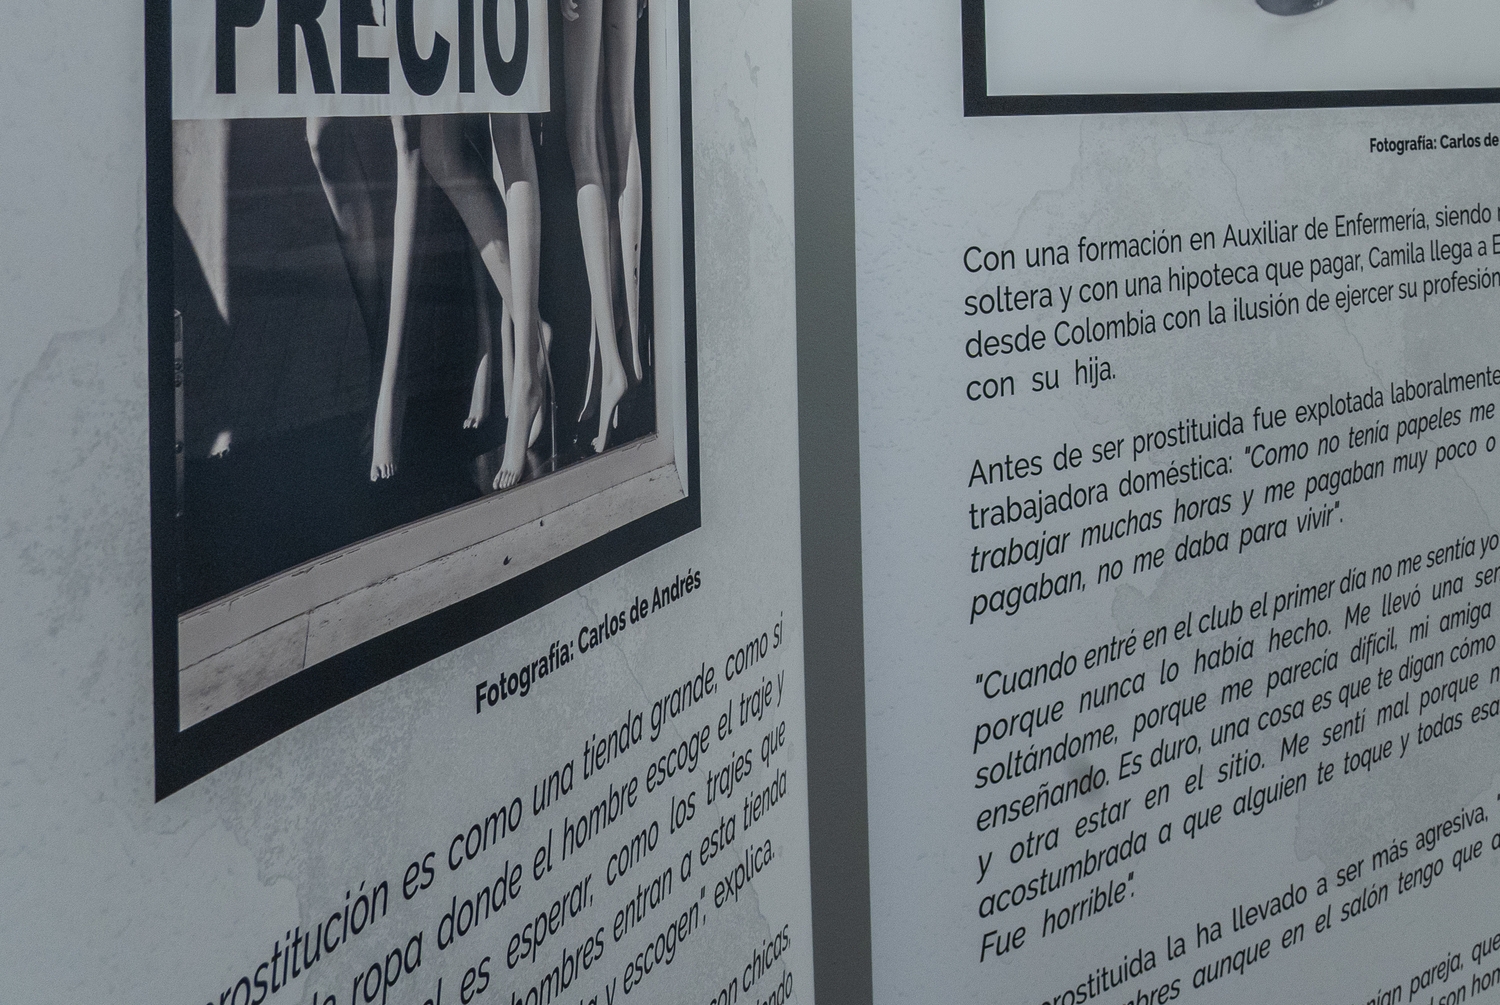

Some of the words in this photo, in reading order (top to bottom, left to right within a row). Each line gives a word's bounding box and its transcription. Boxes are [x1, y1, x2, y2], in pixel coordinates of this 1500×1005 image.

[1370, 135, 1437, 156] Fotografía:
[1440, 133, 1481, 149] Carlos
[1483, 132, 1499, 147] de
[963, 246, 1015, 273] Con
[1026, 245, 1069, 268] una
[1077, 229, 1182, 263] formación
[1190, 231, 1215, 251] en
[1223, 220, 1298, 248] Auxiliar
[1305, 217, 1328, 240] de
[1335, 208, 1429, 237] Enfermería,
[1436, 203, 1491, 227] siendo
[965, 324, 1046, 359] desde
[1054, 309, 1156, 347] Colombia
[1163, 309, 1200, 331] con
[1208, 301, 1226, 325] la
[1234, 292, 1299, 322] ilusión
[1306, 289, 1330, 312] de
[1335, 284, 1394, 313] ejercer
[1399, 282, 1417, 299] su
[1423, 268, 1500, 302] profesión
[969, 483, 1108, 530] trabajadora
[1119, 455, 1232, 497] doméstica:
[1245, 442, 1308, 468] "Como
[1318, 435, 1340, 455] no
[1349, 420, 1389, 449] tenía
[1396, 407, 1461, 444] papeles
[1470, 403, 1495, 422] me
[476, 640, 574, 714] Fotografía:
[578, 611, 626, 654] Carlos
[630, 596, 649, 624] de
[651, 568, 701, 613] Andrés
[970, 571, 1085, 625] pagaban,
[1097, 560, 1123, 584] no
[1133, 548, 1165, 574] me
[1175, 530, 1229, 562] daba
[1239, 519, 1287, 554] para
[976, 651, 1077, 699] "Cuando
[1084, 629, 1137, 669] entré
[1143, 626, 1167, 650] en
[1174, 612, 1192, 641] el
[1198, 600, 1243, 633] club
[1250, 592, 1267, 619] el
[1273, 580, 1335, 620] primer
[1340, 568, 1366, 594] día
[1372, 564, 1392, 585] no
[1397, 554, 1422, 577] me
[1426, 539, 1475, 568] sentía
[1480, 534, 1499, 559] yo
[402, 851, 435, 900] es
[448, 797, 522, 871] como
[533, 759, 574, 816] una
[583, 710, 643, 780] tienda
[650, 662, 717, 742] grande,
[725, 632, 768, 681] como
[773, 612, 783, 650] si
[975, 724, 1117, 789] soltándome,
[1132, 692, 1207, 742] porque
[1221, 678, 1253, 705] me
[1266, 652, 1338, 698] parecía
[1350, 627, 1397, 665] difícil,
[1410, 616, 1428, 643] mi
[1440, 602, 1491, 632] amiga
[437, 860, 522, 950] donde
[533, 829, 552, 881] el
[562, 777, 638, 860] hombre
[646, 725, 710, 793] escoge
[718, 700, 732, 741] el
[740, 675, 772, 727] traje
[777, 670, 784, 707] y
[460, 956, 490, 1005] es
[507, 874, 593, 969] esperar,
[607, 821, 659, 886] como
[670, 791, 696, 834] los
[707, 749, 752, 805] trajes
[761, 721, 785, 767] que
[613, 867, 672, 942] entran
[680, 850, 692, 882] a
[700, 815, 736, 866] esta
[744, 769, 786, 831] tienda
[714, 838, 775, 909] explica.
[979, 830, 1147, 918] acostumbrada
[1158, 823, 1172, 844] a
[1183, 804, 1222, 839] que
[1233, 773, 1307, 816] alguien
[1318, 762, 1334, 785] te
[1344, 740, 1392, 774] toque
[1400, 733, 1409, 758] y
[1418, 713, 1463, 745] todas
[980, 926, 1026, 963] Fue
[1167, 936, 1186, 961] la
[1197, 922, 1222, 948] ha
[1233, 884, 1307, 932] llevado
[1317, 877, 1328, 896] a
[1337, 859, 1364, 887] ser
[1372, 840, 1408, 870] más
[1416, 807, 1488, 851] agresiva,
[743, 924, 790, 992] chicas,
